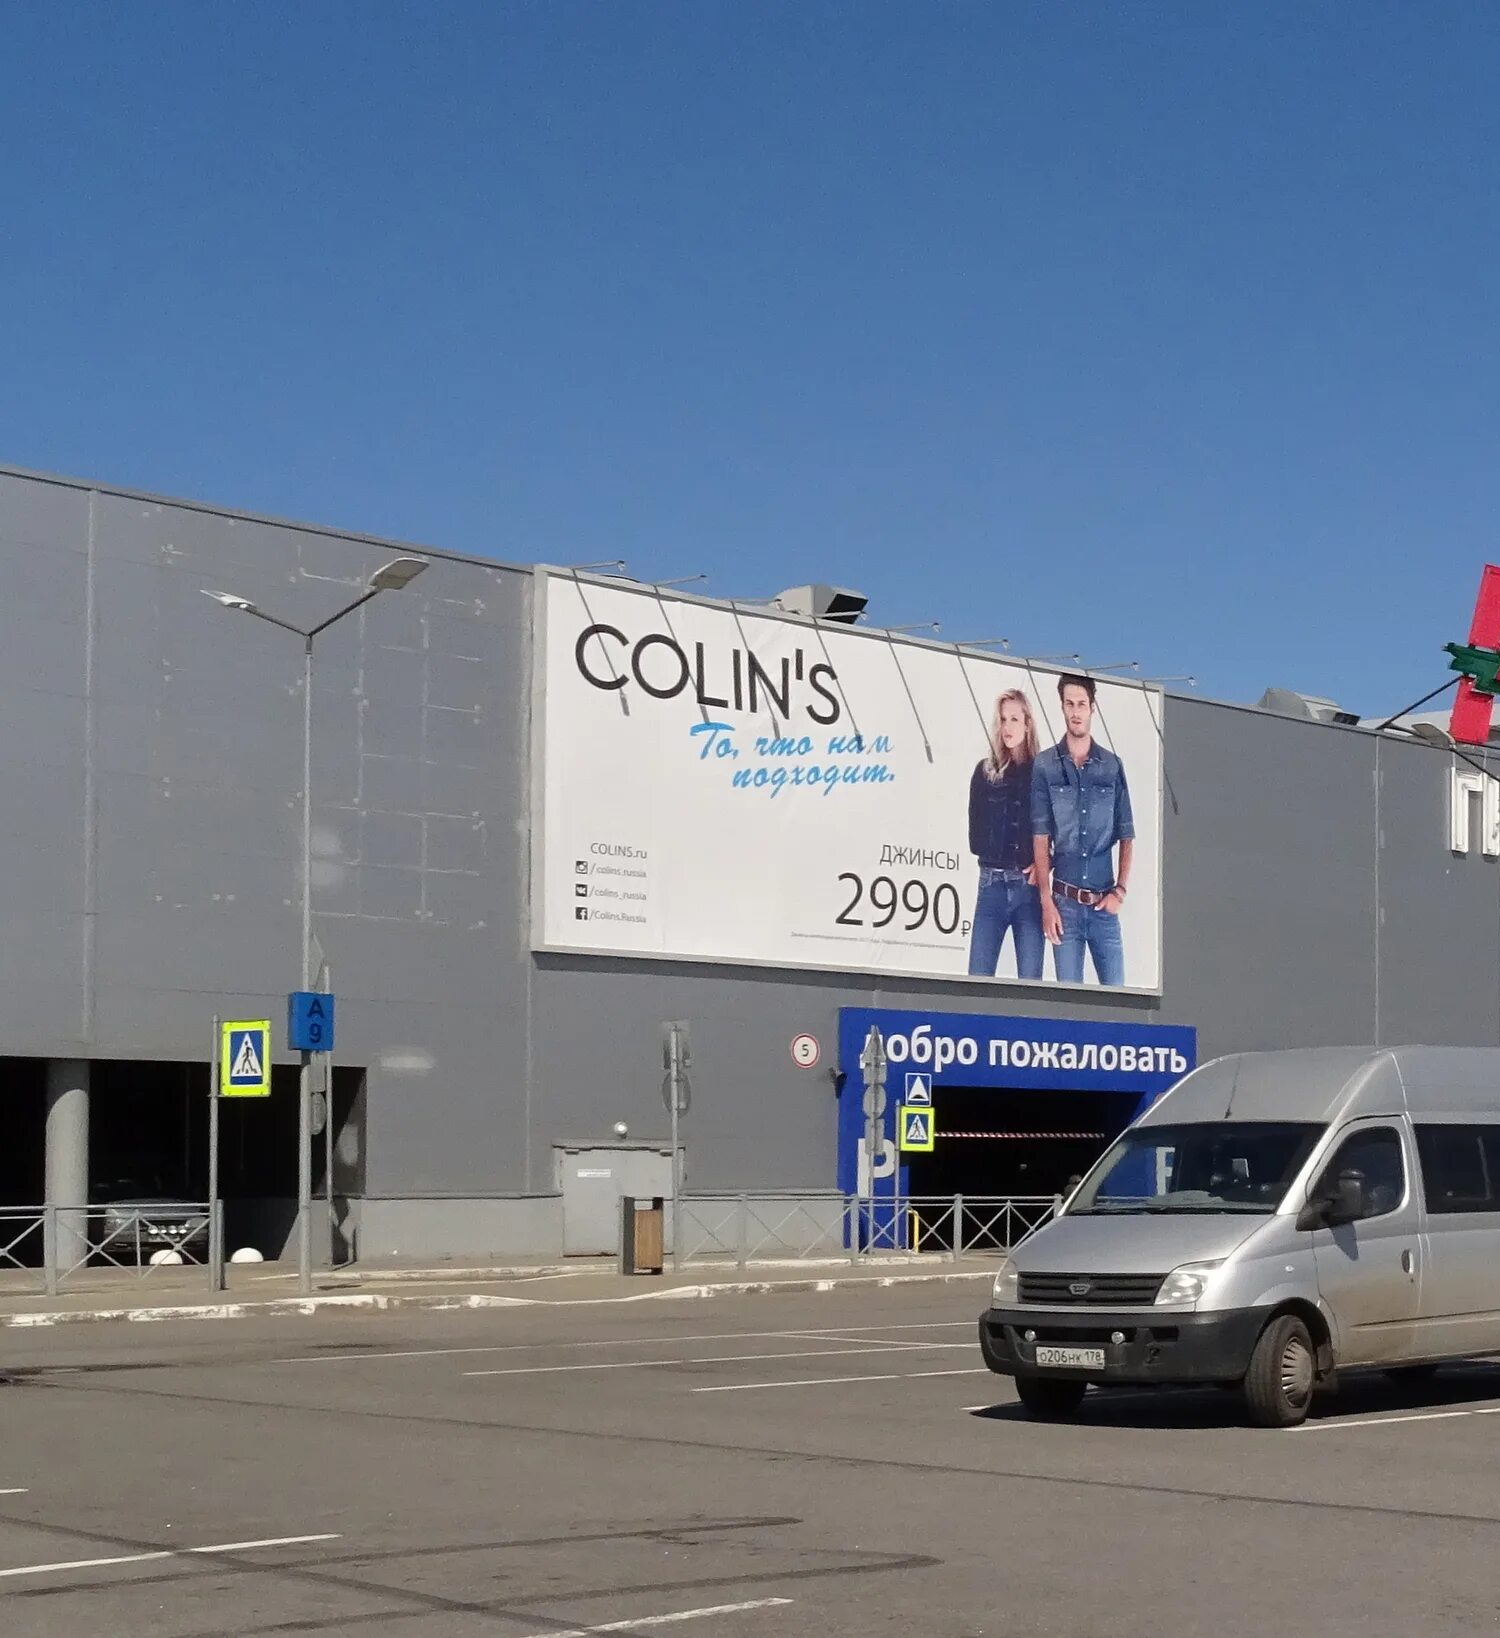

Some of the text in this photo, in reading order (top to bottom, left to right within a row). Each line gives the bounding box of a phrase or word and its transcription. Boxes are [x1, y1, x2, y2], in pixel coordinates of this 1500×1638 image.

[575, 623, 840, 726] COLIN'S
[689, 722, 894, 760] То, что нам
[732, 763, 895, 799] подходит.
[590, 842, 648, 859] COLINS.ru
[880, 844, 959, 871] ДЖИНСЫ
[310, 1023, 321, 1043] 9
[802, 1044, 809, 1057] 5
[989, 1039, 1188, 1073] пожаловать
